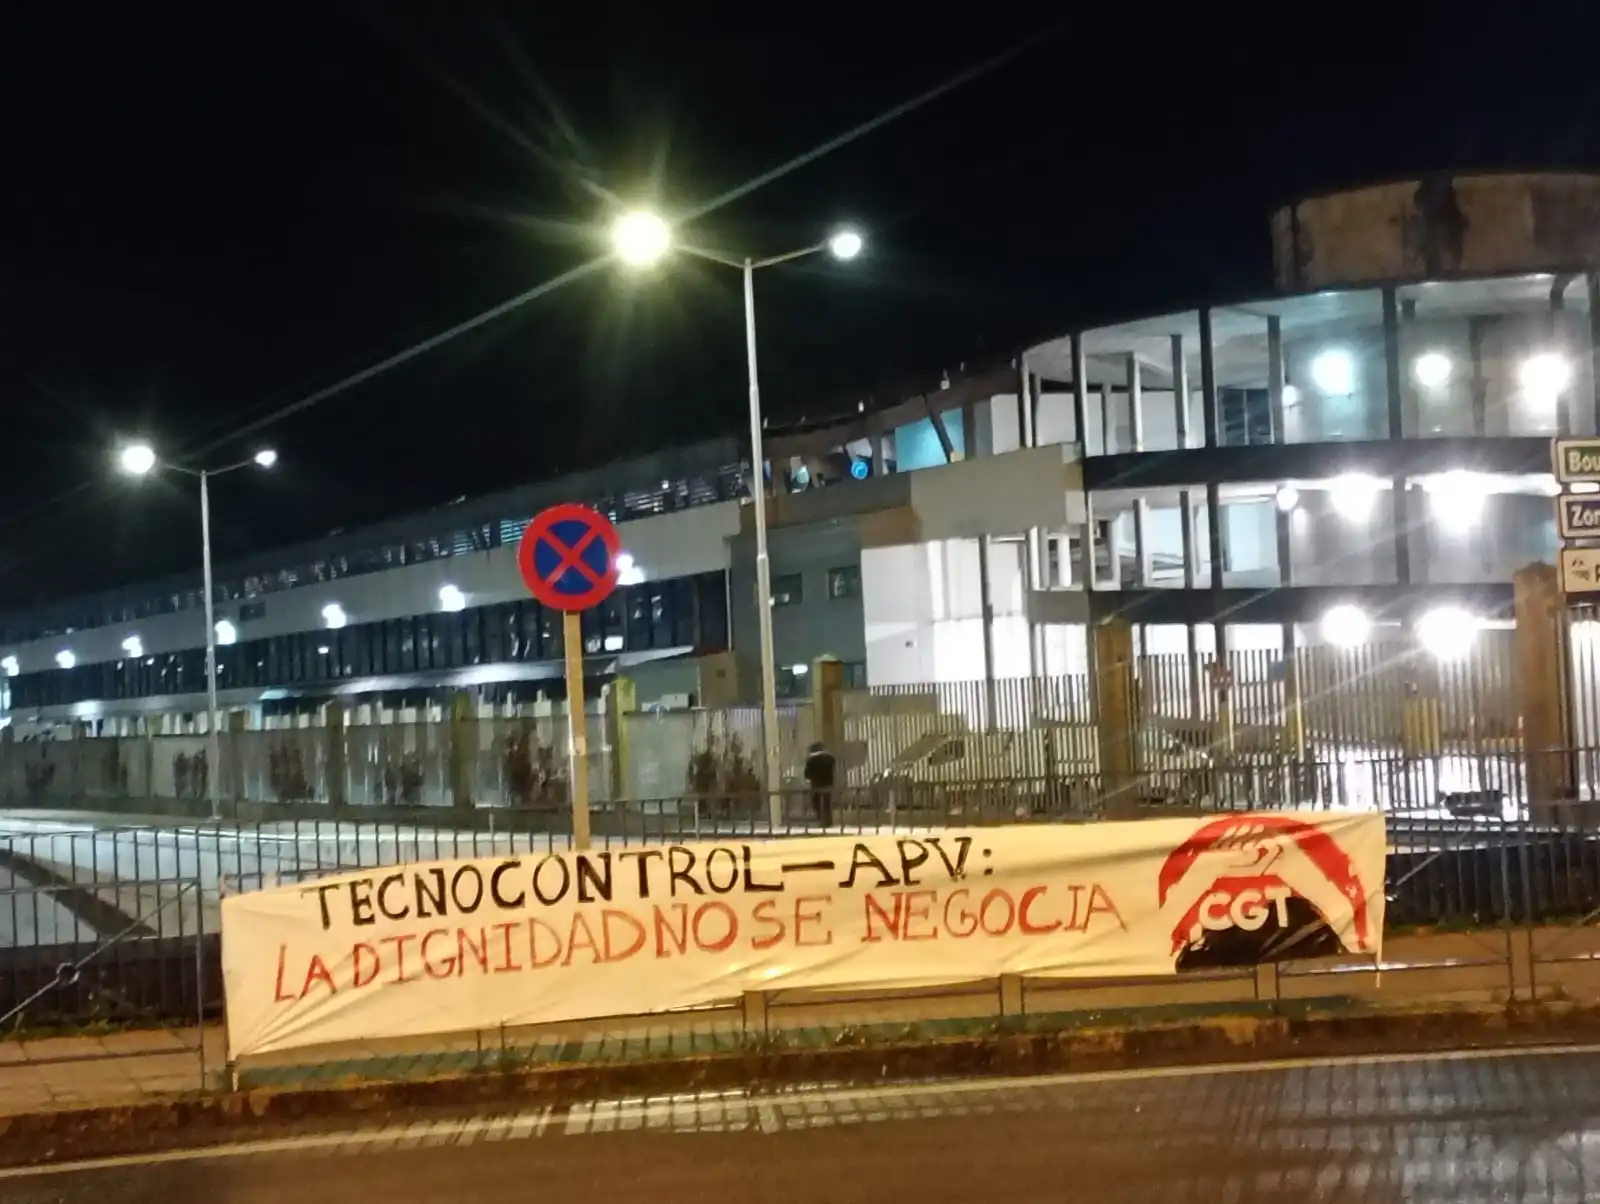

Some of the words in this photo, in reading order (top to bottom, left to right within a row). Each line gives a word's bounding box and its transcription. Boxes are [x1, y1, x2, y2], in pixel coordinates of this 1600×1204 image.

[274, 944, 338, 1003] LA
[750, 894, 833, 949] SE
[861, 884, 1128, 944] NEGOCIA
[1199, 885, 1292, 931] CGT
